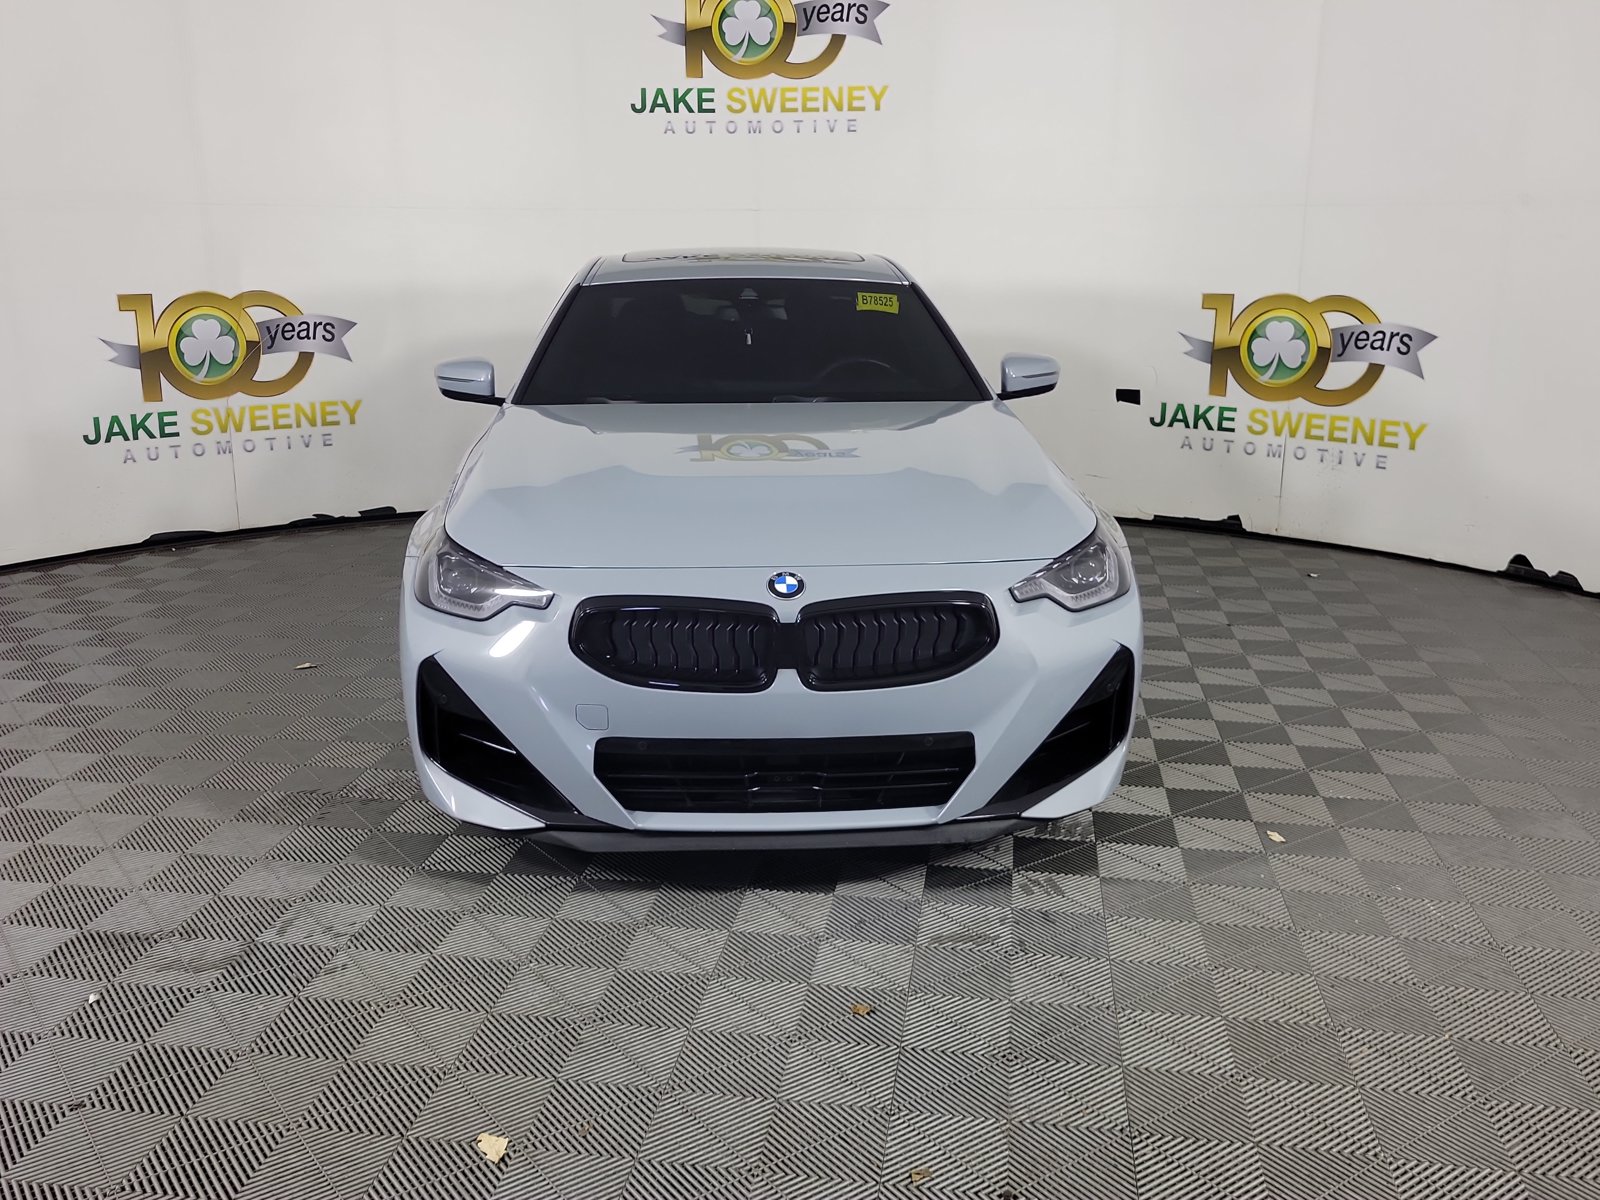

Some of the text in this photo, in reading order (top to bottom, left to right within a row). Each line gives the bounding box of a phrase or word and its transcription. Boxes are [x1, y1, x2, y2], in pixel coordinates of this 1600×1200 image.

[802, 2, 869, 31] years
[630, 85, 889, 114] JAKE SWEENEY
[663, 119, 858, 135] AUTOMOTIVE
[861, 295, 894, 307] B78525
[117, 290, 316, 403] 100
[265, 320, 337, 350] years
[1201, 293, 1386, 408] 100
[1337, 328, 1413, 357] years
[82, 399, 363, 446] JAKE SWEENEY
[1149, 402, 1428, 451] JAKE SWEENEY
[122, 433, 335, 465] AUTOMOTIVE
[1180, 435, 1389, 470] AUTOMOTIVE
